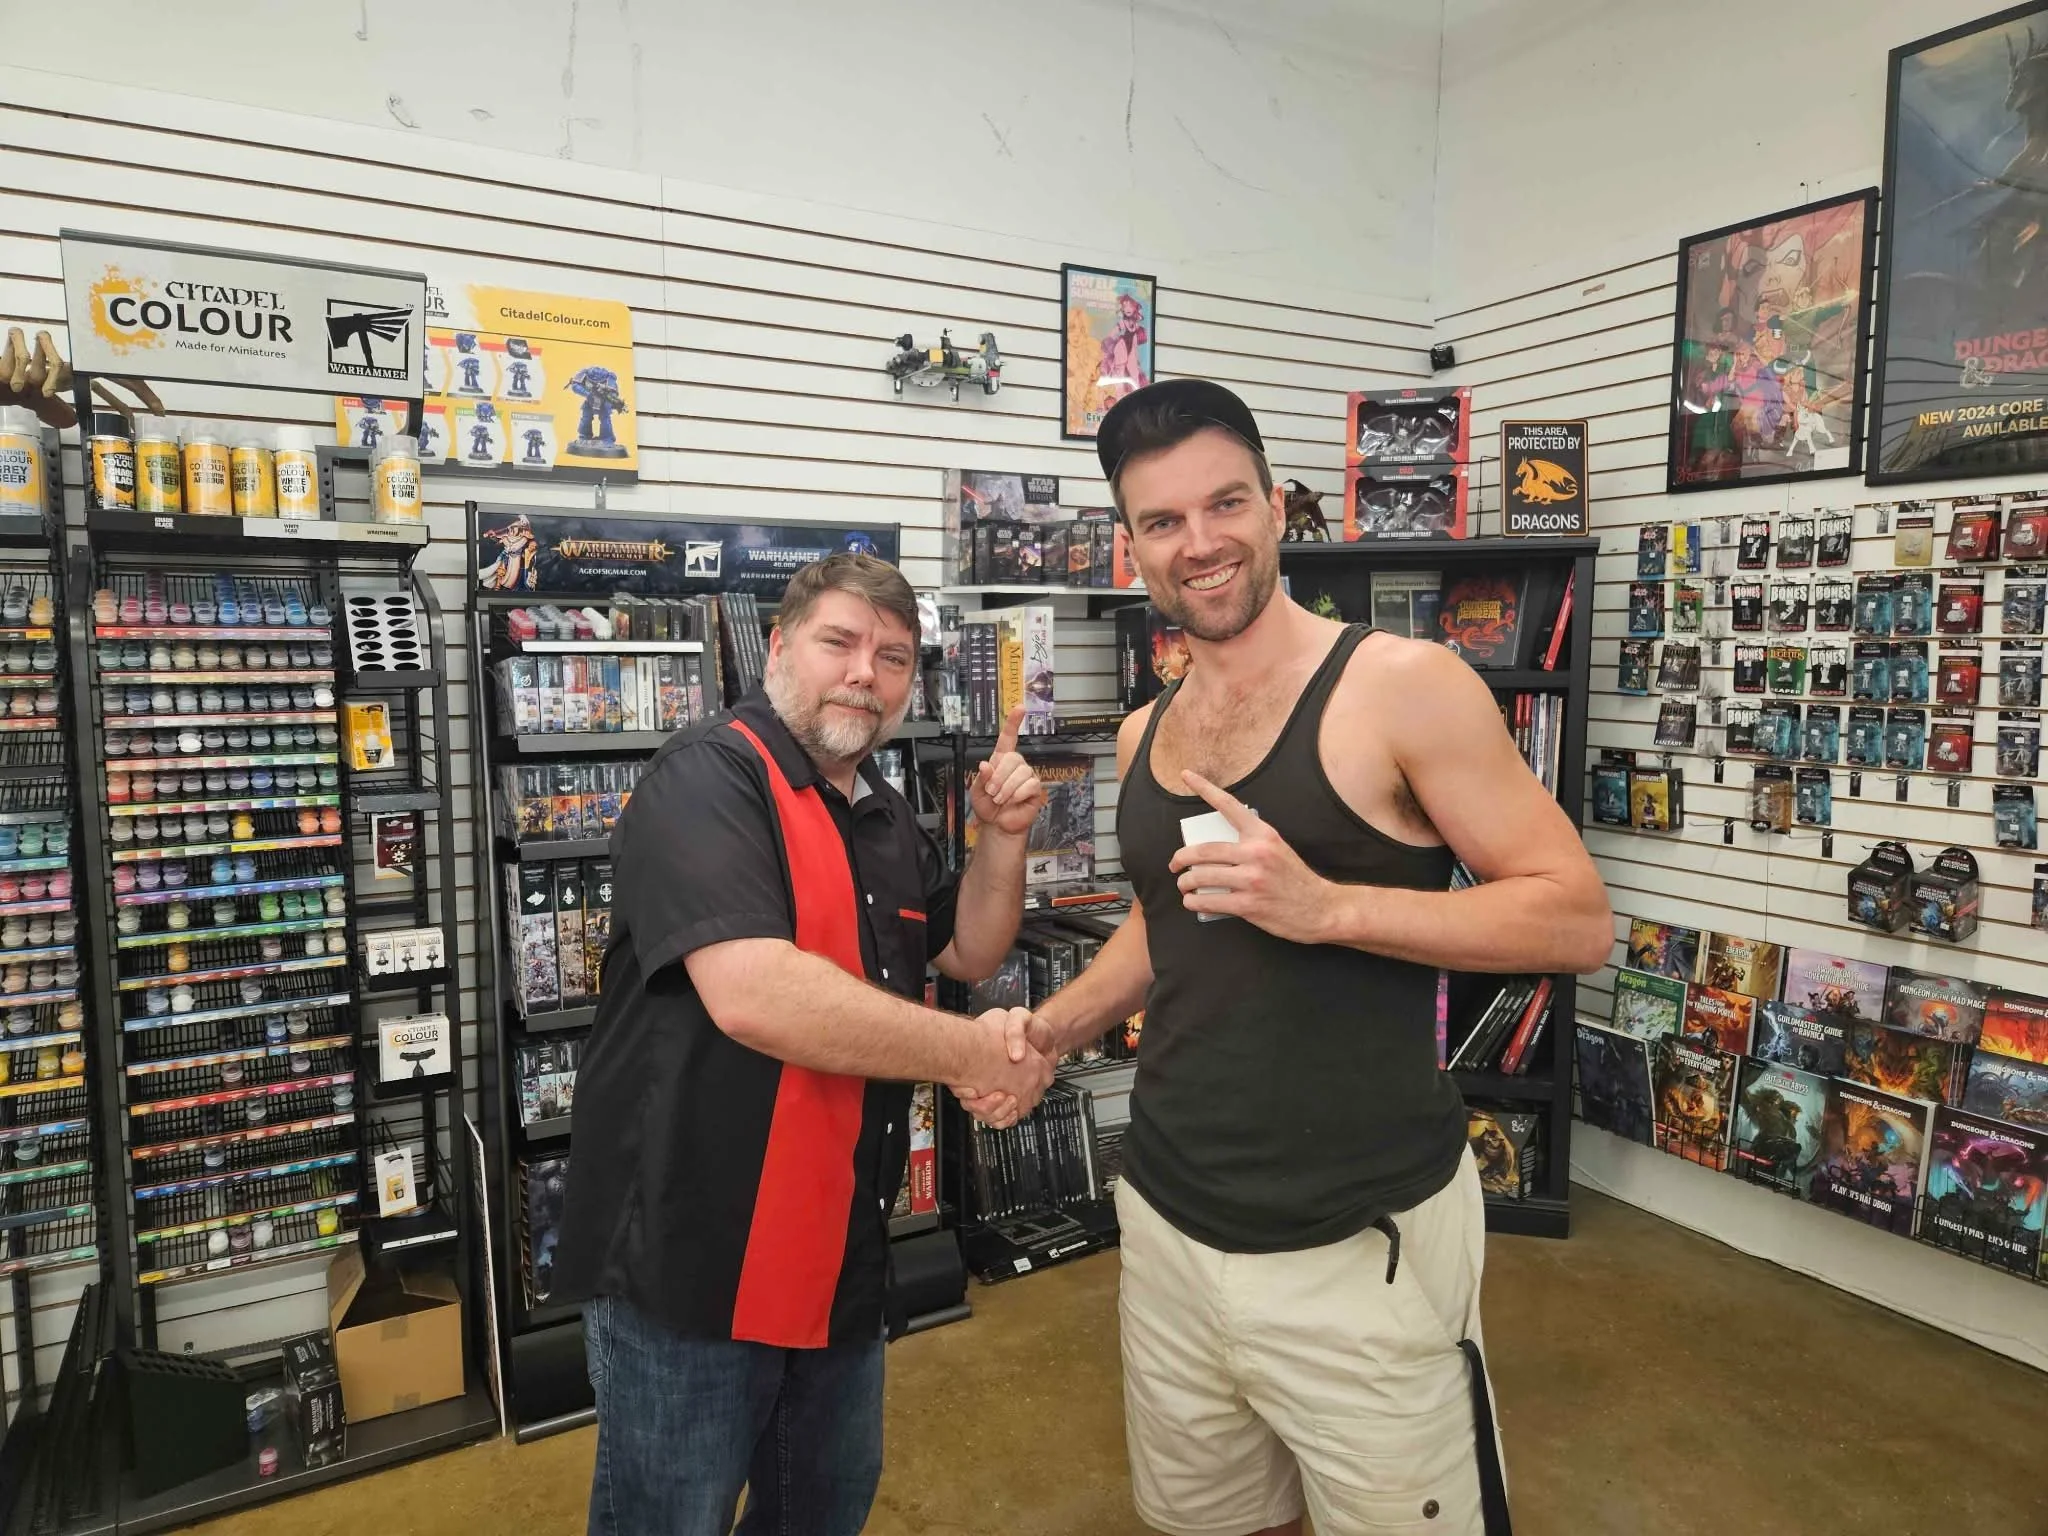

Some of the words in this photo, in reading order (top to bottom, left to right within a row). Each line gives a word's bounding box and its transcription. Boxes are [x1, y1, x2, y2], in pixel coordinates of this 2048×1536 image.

[165, 281, 288, 310] CITADEL
[109, 298, 293, 343] COLOUR
[500, 307, 610, 329] CitadelColour.com
[175, 340, 207, 352] Made
[210, 343, 225, 354] for
[229, 345, 287, 359] Miniatures
[1954, 328, 2048, 360] DUNGE
[330, 363, 408, 380] WARHAMMER
[1919, 410, 1954, 426] NEW
[1957, 404, 1995, 421] 2024
[1999, 398, 2044, 416] CORE
[1523, 427, 1543, 436] THIS
[1544, 426, 1568, 436] AREA
[1962, 415, 2048, 438] AVAILABLE
[1508, 437, 1565, 450] PROTECTED
[1567, 437, 1581, 450] BY
[1511, 514, 1580, 530] DRAGONS
[1779, 520, 1813, 538] BONES
[1819, 518, 1850, 537] BONES
[1742, 524, 1767, 537] BONES
[560, 540, 665, 561] WARHAMMER
[748, 550, 820, 563] WARHAMMER
[1733, 586, 1760, 599] BONES
[1770, 585, 1807, 601] BONES
[1815, 585, 1850, 601] BONES
[1737, 647, 1763, 661] BONES
[1811, 650, 1846, 665] BONES
[1008, 646, 1020, 708] MEDIEVA
[1727, 710, 1760, 727] BONES
[1033, 766, 1085, 781] WARRIORS
[1619, 973, 1647, 988] Dragon
[1700, 995, 1714, 1005] TALES
[1900, 985, 1931, 998] DUNGEON
[1951, 996, 1966, 1006] MAD
[1967, 1000, 1987, 1010] MAGE
[1717, 1007, 1736, 1019] PORTAL
[2004, 1002, 2044, 1015] DUNGEONS
[395, 1031, 439, 1043] COLOUR
[1576, 1029, 1605, 1045] Dragon
[1798, 1027, 1825, 1041] RAVNICA
[1824, 1026, 1844, 1037] GUIDE
[1986, 1063, 2026, 1078] DUNGEONS
[1790, 1081, 1809, 1093] ABYSS
[1839, 1091, 1873, 1106] DUNGEONS
[1873, 1100, 1882, 1111] &
[1882, 1105, 1912, 1119] DRAGONS
[1951, 1121, 1989, 1137] DUNGEONS
[1989, 1130, 2000, 1141] &
[2000, 1135, 2035, 1150] DRAGONS
